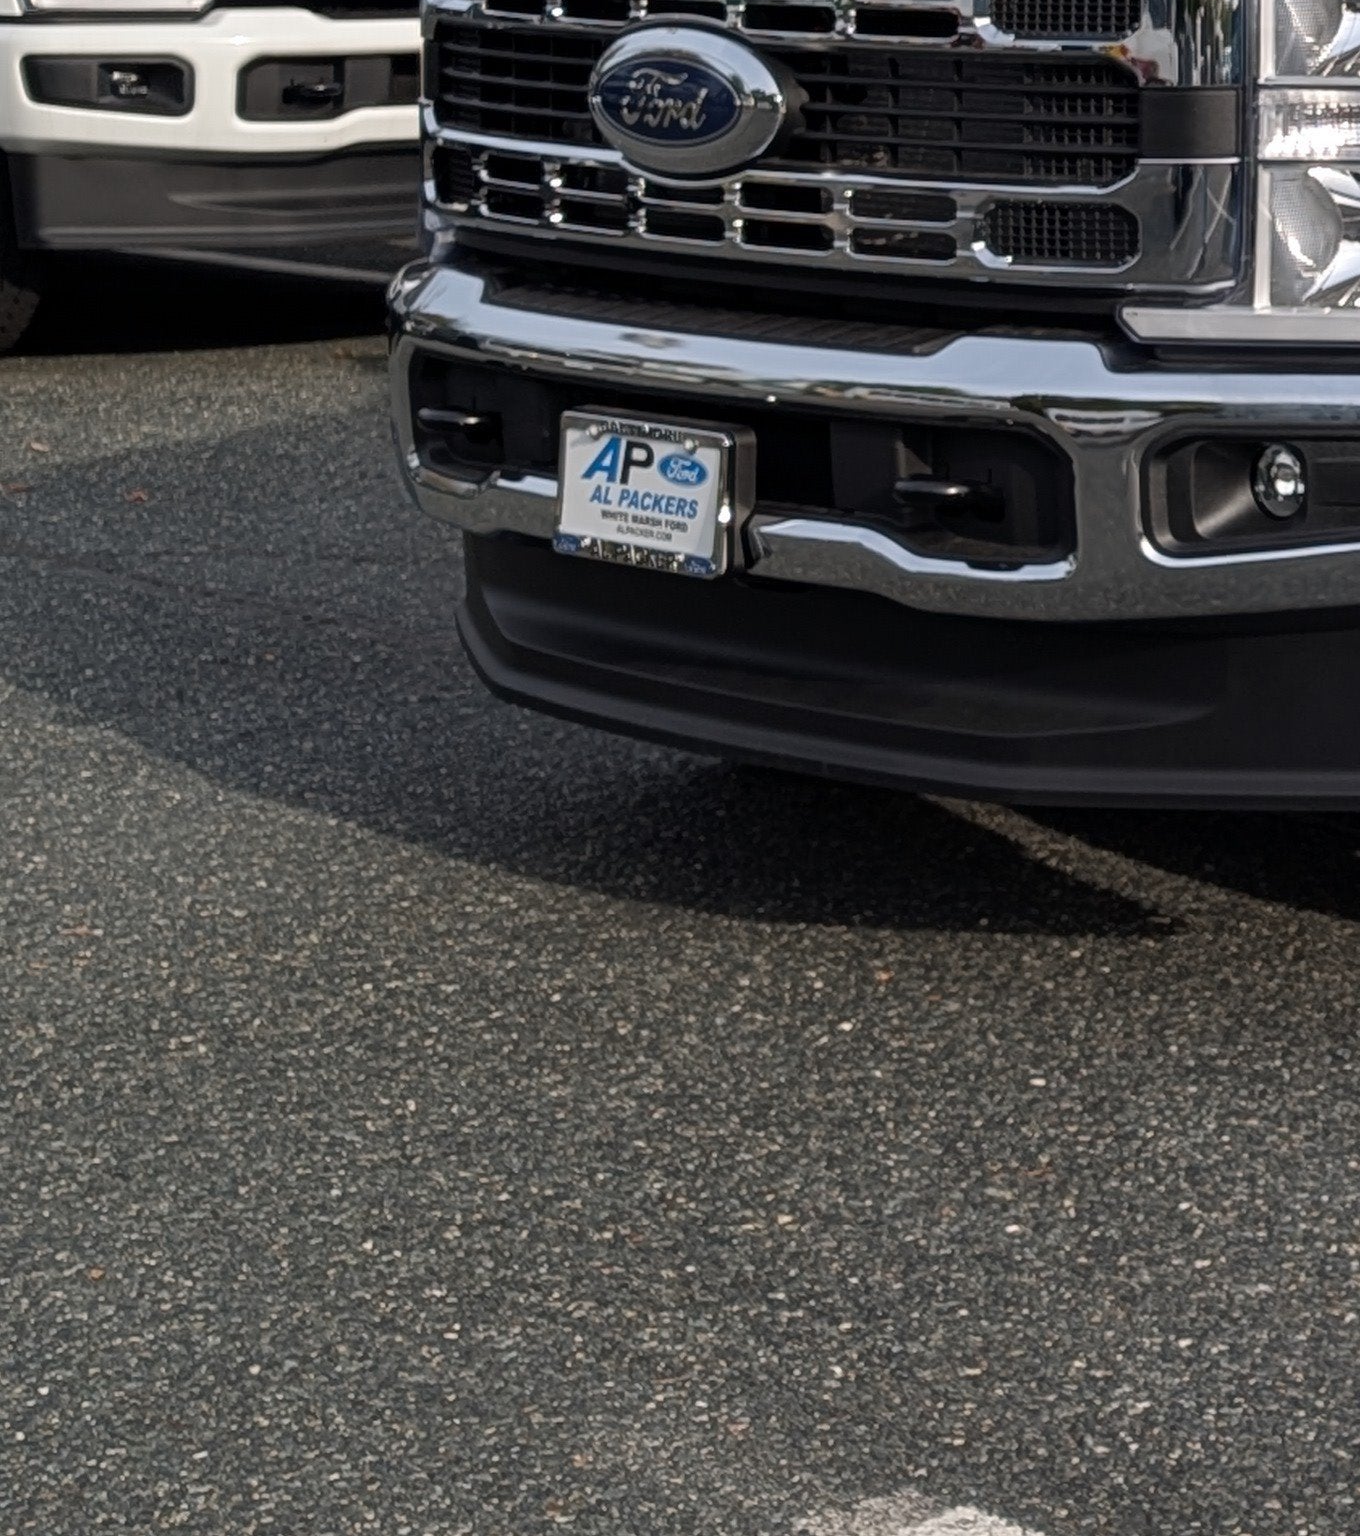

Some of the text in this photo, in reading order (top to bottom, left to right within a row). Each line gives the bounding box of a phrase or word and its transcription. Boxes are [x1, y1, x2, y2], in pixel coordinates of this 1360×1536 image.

[619, 66, 708, 131] Ford
[666, 455, 700, 483] Ford
[590, 485, 699, 520] AL PACKERS
[601, 509, 689, 533] WHITE MARSH FORD
